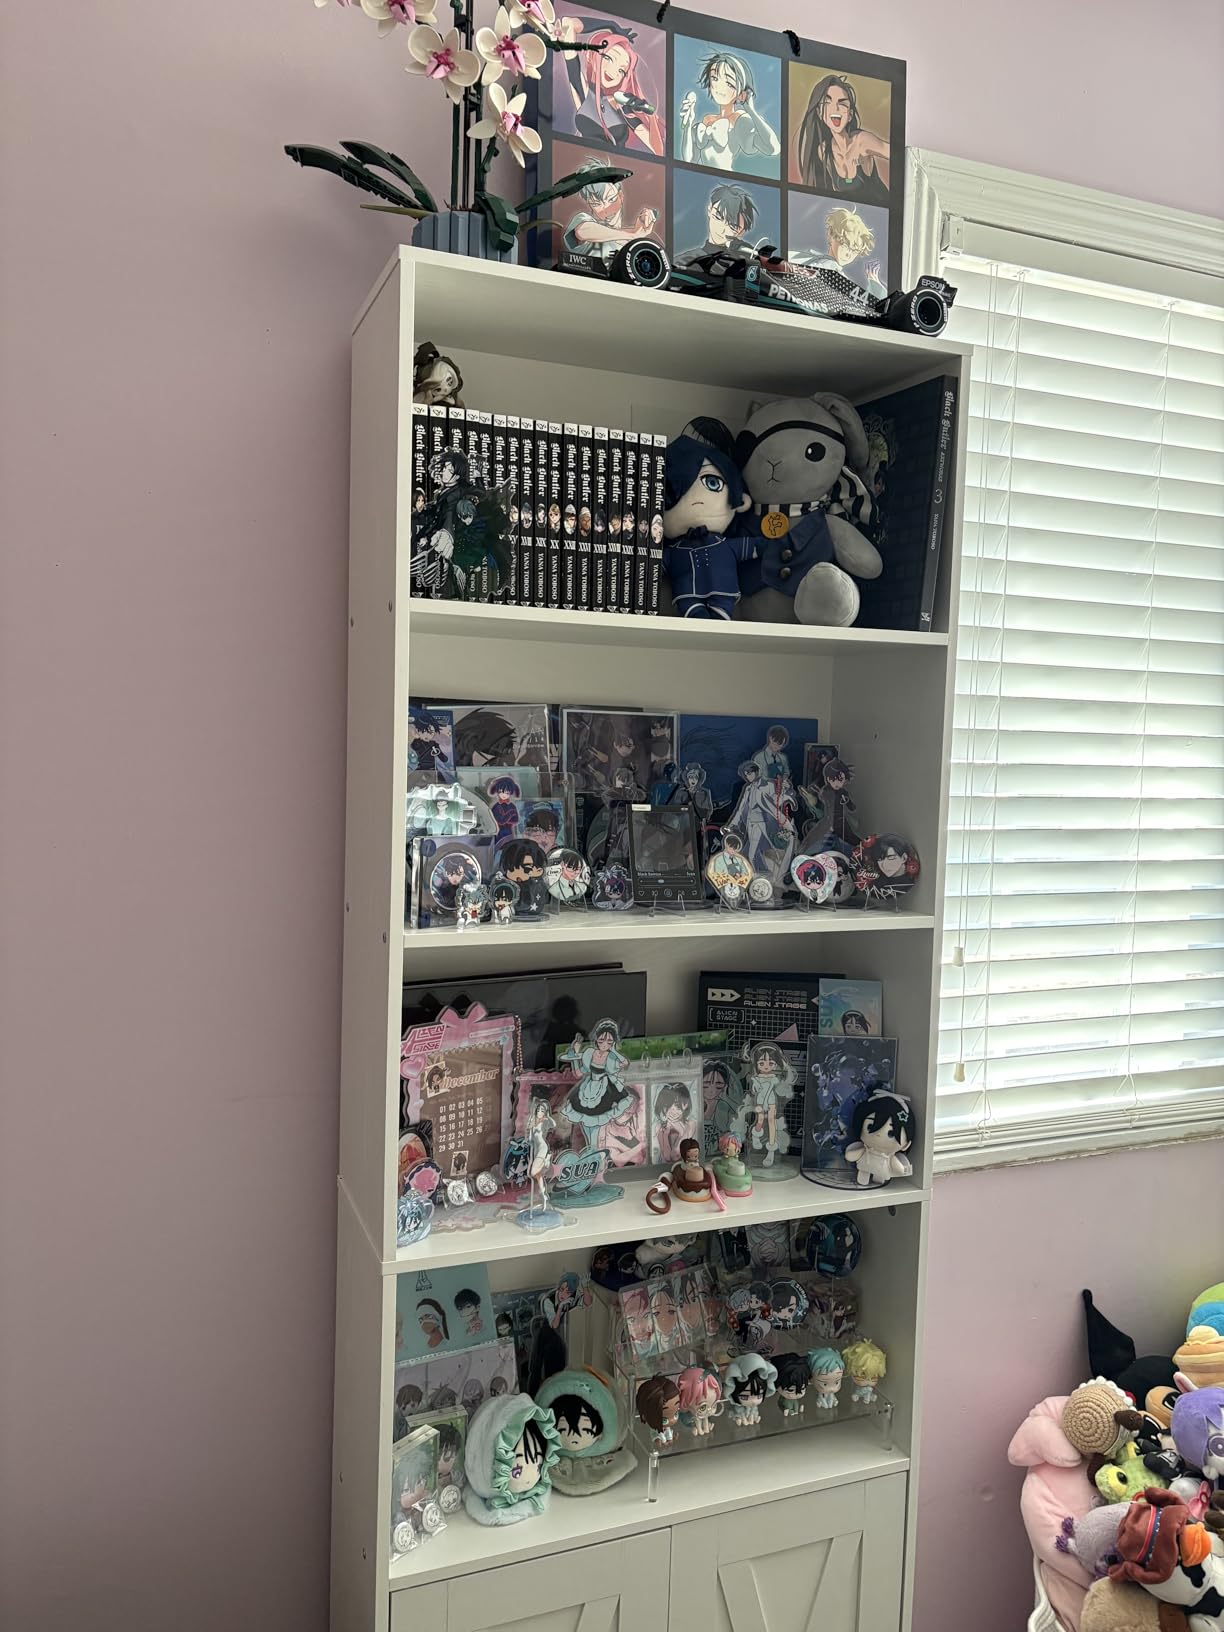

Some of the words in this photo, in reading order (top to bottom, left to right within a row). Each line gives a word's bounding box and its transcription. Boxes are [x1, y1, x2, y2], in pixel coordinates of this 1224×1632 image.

[570, 254, 587, 265] IWC
[849, 286, 870, 305] 44
[921, 278, 945, 291] EPSON
[944, 391, 954, 417] Black
[415, 424, 426, 450] Black
[433, 427, 444, 451] Black
[467, 430, 478, 455] Black
[480, 433, 491, 458] Black
[941, 419, 951, 450] Butler
[494, 436, 505, 460] Black
[508, 437, 519, 461] Black
[522, 439, 533, 463] Black
[537, 440, 548, 465] Black
[550, 443, 560, 467] Black
[566, 444, 577, 468] Black
[581, 446, 592, 471] Black
[597, 448, 607, 473] Black
[612, 447, 622, 472] Black
[414, 452, 426, 483] Butler
[627, 450, 636, 475] Black
[641, 453, 651, 477] Black
[656, 455, 666, 480] Black
[522, 466, 533, 496] Butler
[537, 467, 547, 497] Butler
[550, 470, 560, 499] Butler
[566, 471, 576, 500] Butler
[581, 473, 591, 503] Butler
[597, 475, 607, 505] Butler
[611, 474, 621, 503] Butler
[626, 477, 635, 506] Butler
[640, 479, 649, 508] Butler
[655, 482, 664, 511] Butler
[550, 539, 560, 550] XX
[440, 1105, 446, 1113] 01
[449, 1103, 456, 1111] 02
[458, 1101, 465, 1109] 03
[467, 1099, 474, 1107] 04
[476, 1097, 483, 1105] 05
[449, 1113, 455, 1121] 09
[439, 1134, 446, 1142] 22
[448, 1132, 455, 1140] 23
[457, 1130, 464, 1138] 24
[466, 1128, 474, 1136] 25
[449, 1122, 456, 1131] 16
[458, 1120, 464, 1128] 17
[439, 1144, 446, 1152] 29
[448, 1142, 455, 1150] 30
[457, 1140, 464, 1148] 31
[559, 1161, 598, 1180] SUA
